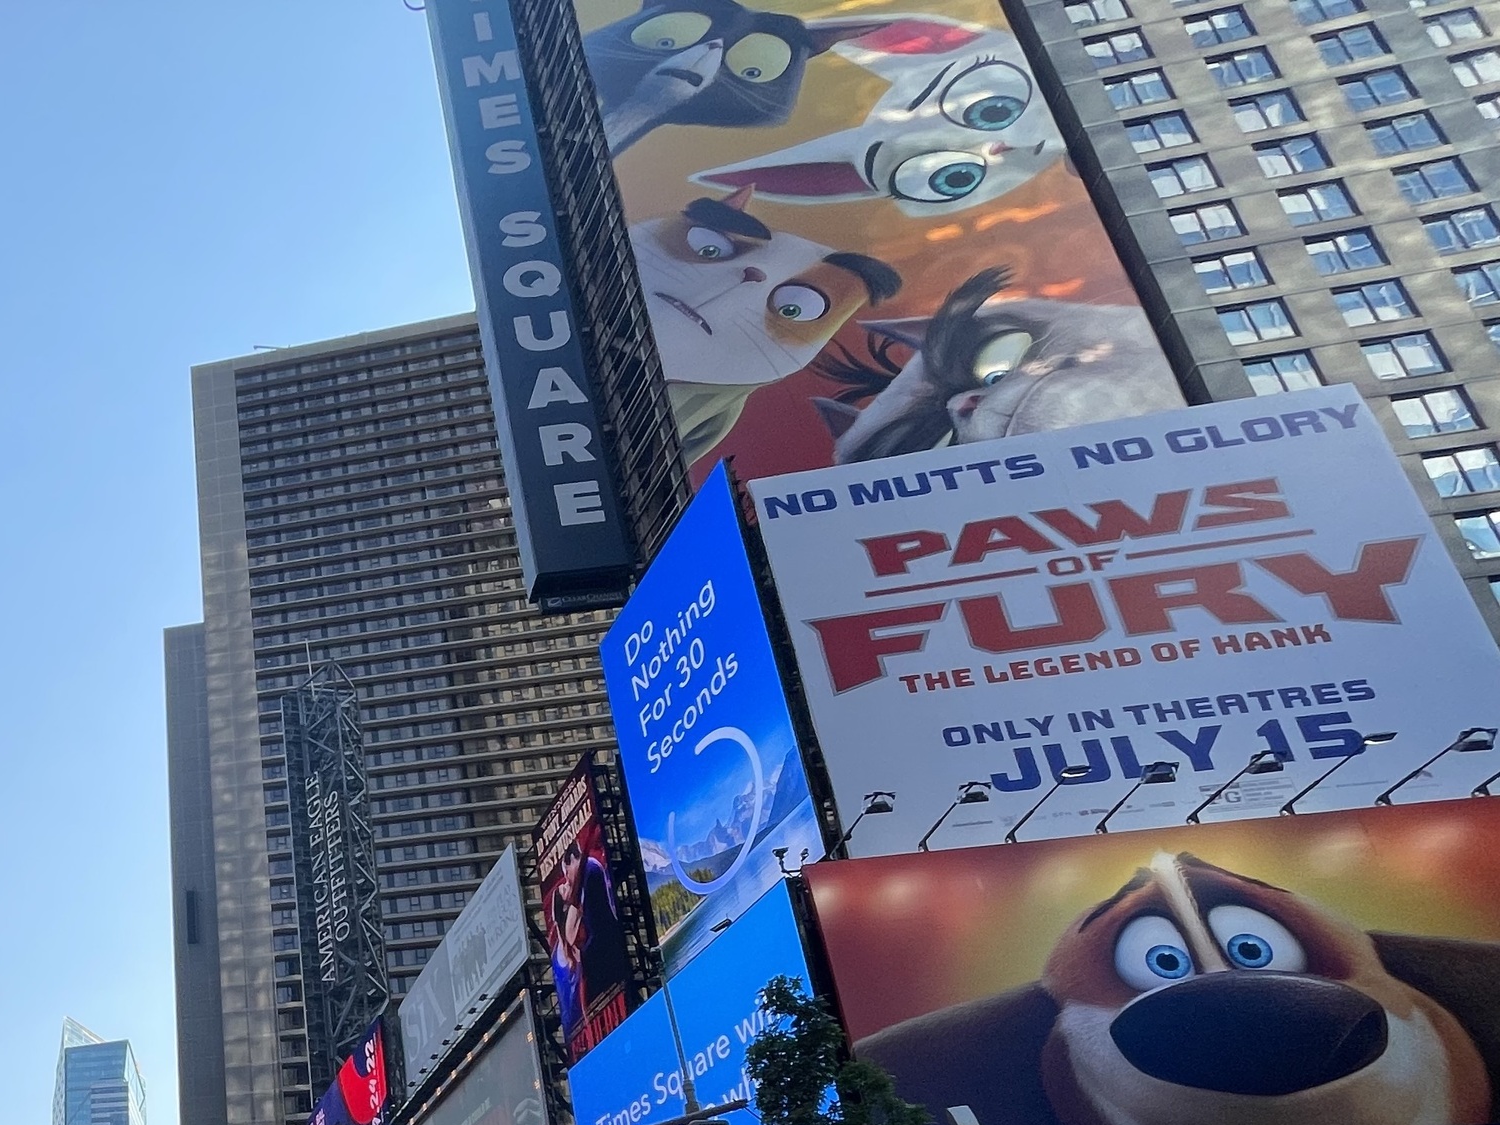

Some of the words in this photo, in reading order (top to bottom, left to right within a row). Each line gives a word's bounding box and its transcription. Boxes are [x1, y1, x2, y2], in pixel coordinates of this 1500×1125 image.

[461, 0, 531, 176] IMES
[498, 210, 606, 527] SQUARE
[764, 488, 838, 520] NO
[852, 452, 1046, 508] MUTTS
[1070, 435, 1153, 470] NO
[1165, 402, 1361, 455] GLORY
[854, 476, 1296, 577] PAWS
[1046, 549, 1121, 577] OF
[623, 620, 654, 667] Do
[630, 579, 716, 701] Nothing
[802, 534, 1427, 696] FURY
[897, 666, 976, 695] THE
[984, 644, 1143, 685] LEGEND
[1151, 637, 1203, 663] OF
[1211, 623, 1334, 655] HANK
[638, 683, 673, 738] For
[675, 637, 705, 688] 30
[646, 652, 739, 774] Seconds
[942, 713, 1053, 749] ONLY
[1070, 707, 1115, 734] IN
[1122, 678, 1377, 727] THEATRES
[990, 725, 1222, 792] JULY
[1255, 710, 1367, 762] 15
[560, 775, 588, 825] AWARDS
[653, 1033, 731, 1106] Square
